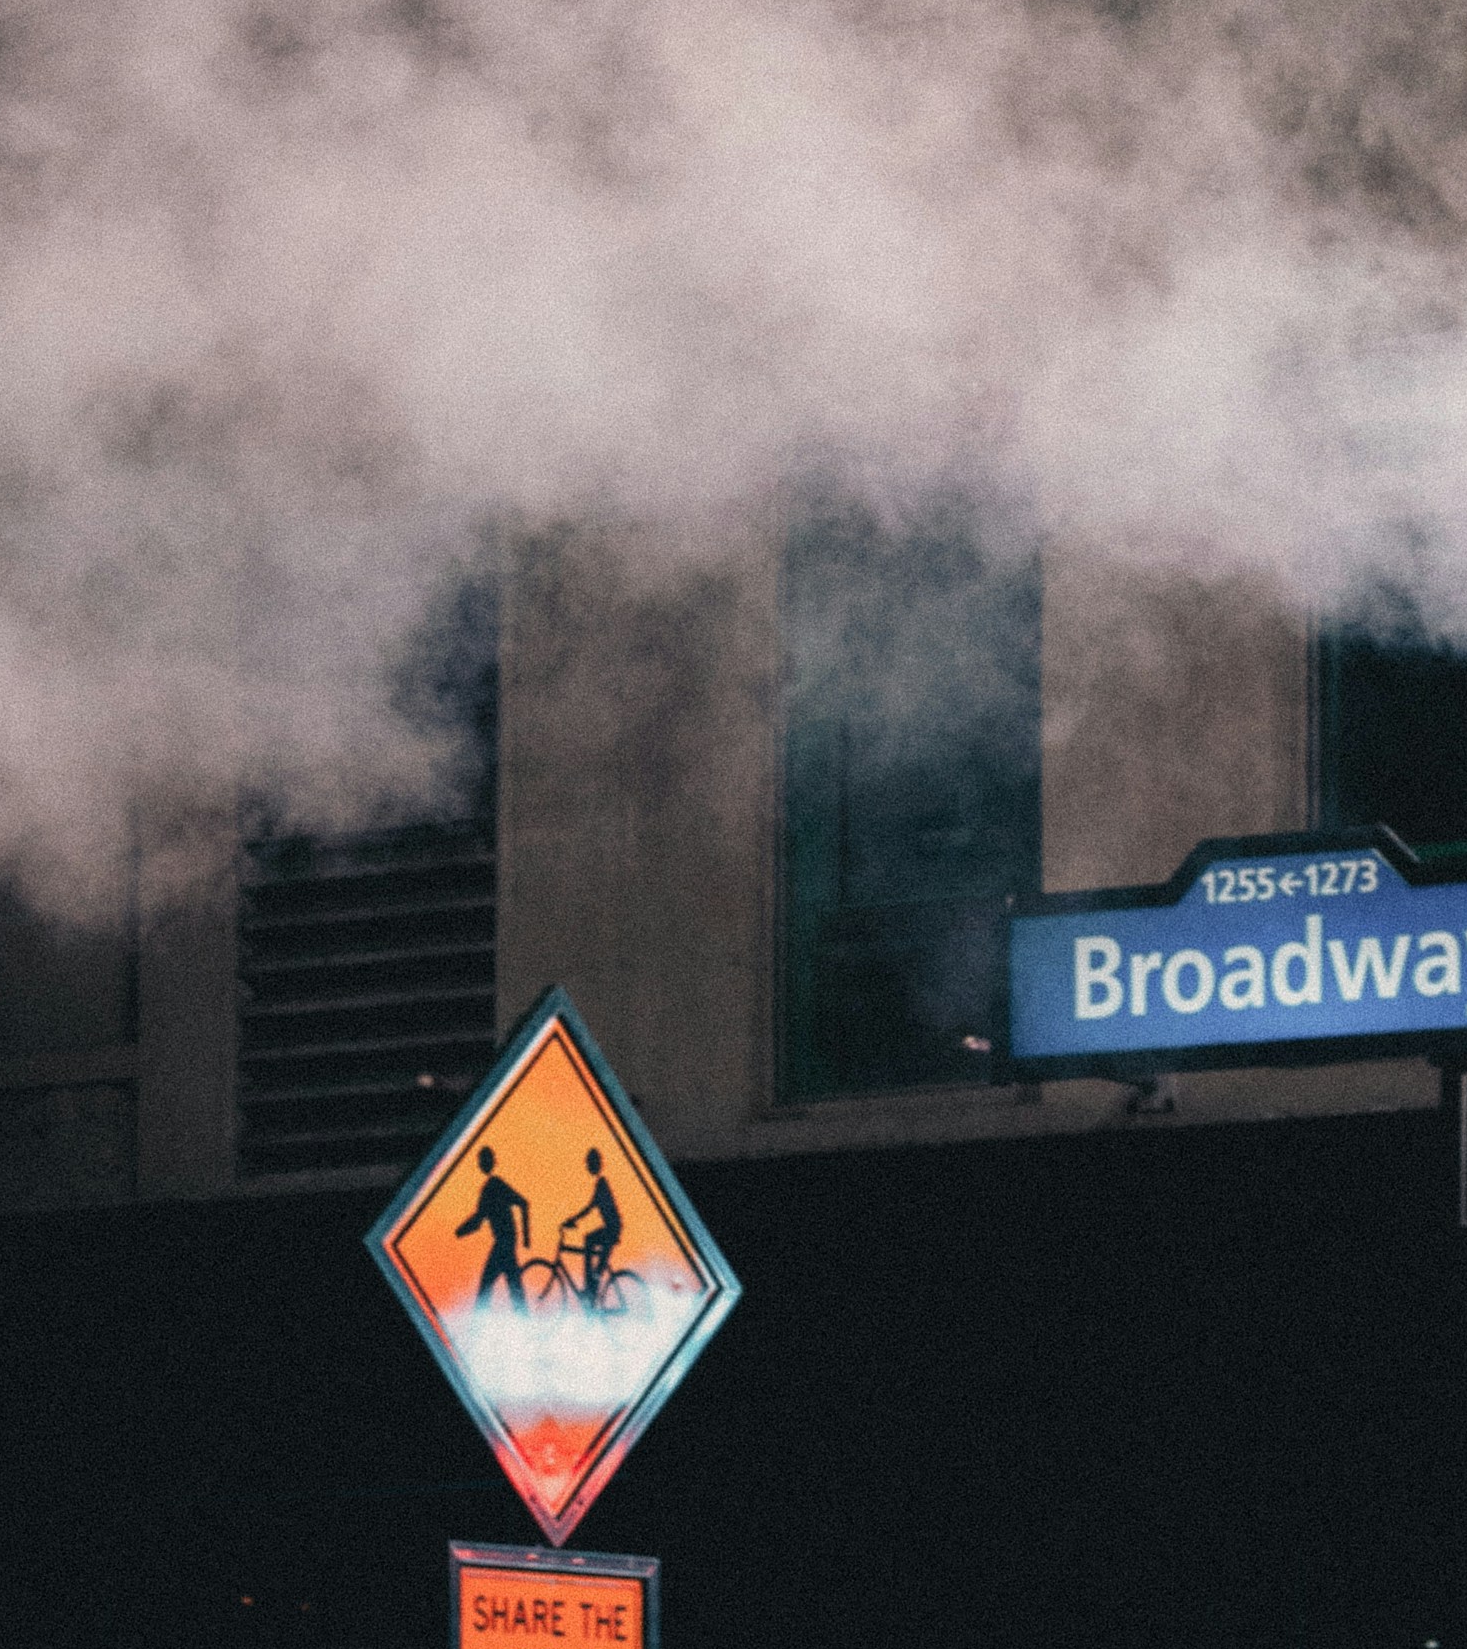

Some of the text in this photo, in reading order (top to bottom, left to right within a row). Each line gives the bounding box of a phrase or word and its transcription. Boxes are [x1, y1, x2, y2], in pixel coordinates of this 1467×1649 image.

[1200, 858, 1379, 903] 1255 1273
[472, 1594, 628, 1642] SHARE THE
